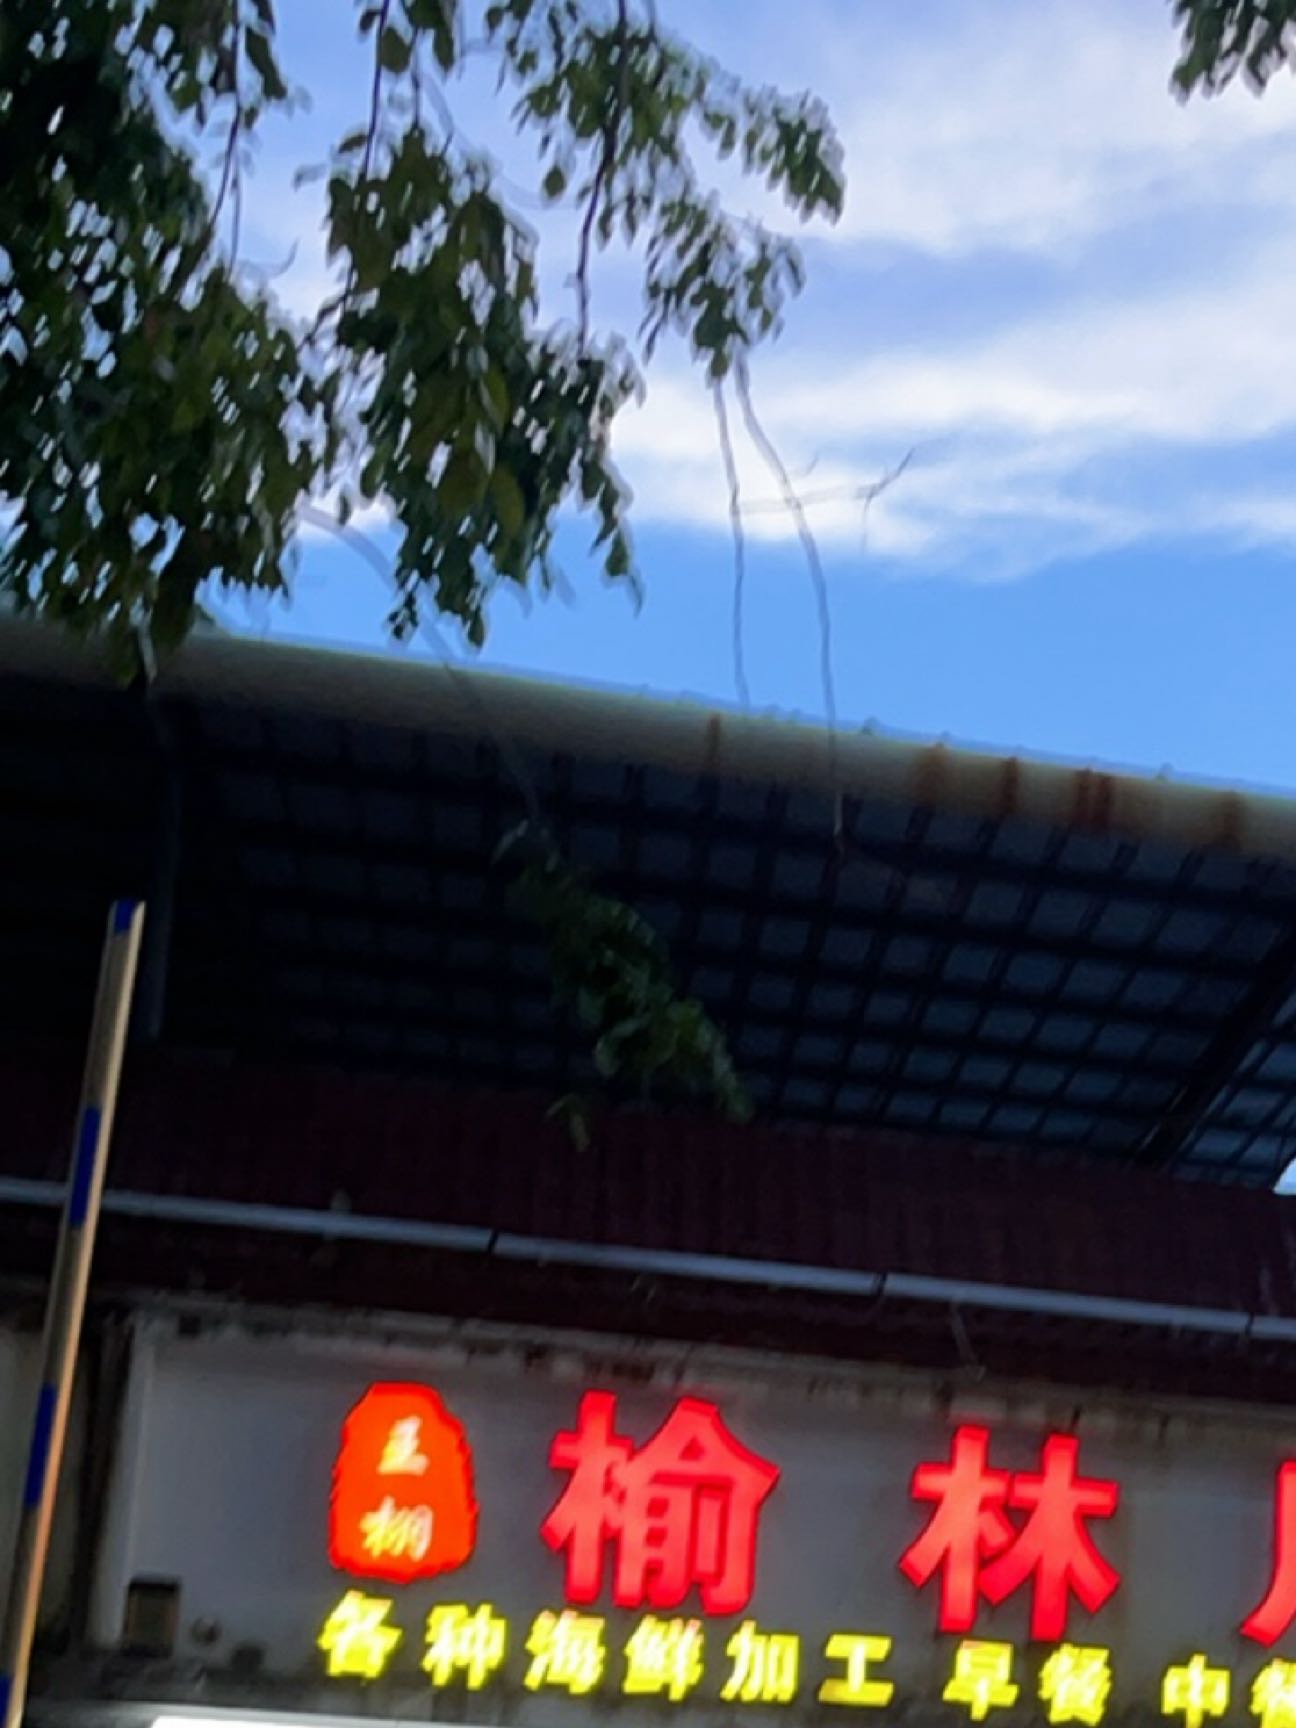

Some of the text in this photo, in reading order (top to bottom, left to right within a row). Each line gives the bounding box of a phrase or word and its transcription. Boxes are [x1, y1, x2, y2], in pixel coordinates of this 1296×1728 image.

[317, 1590, 895, 1706] 各种海鲜加工
[943, 1640, 1112, 1727] 早餐
